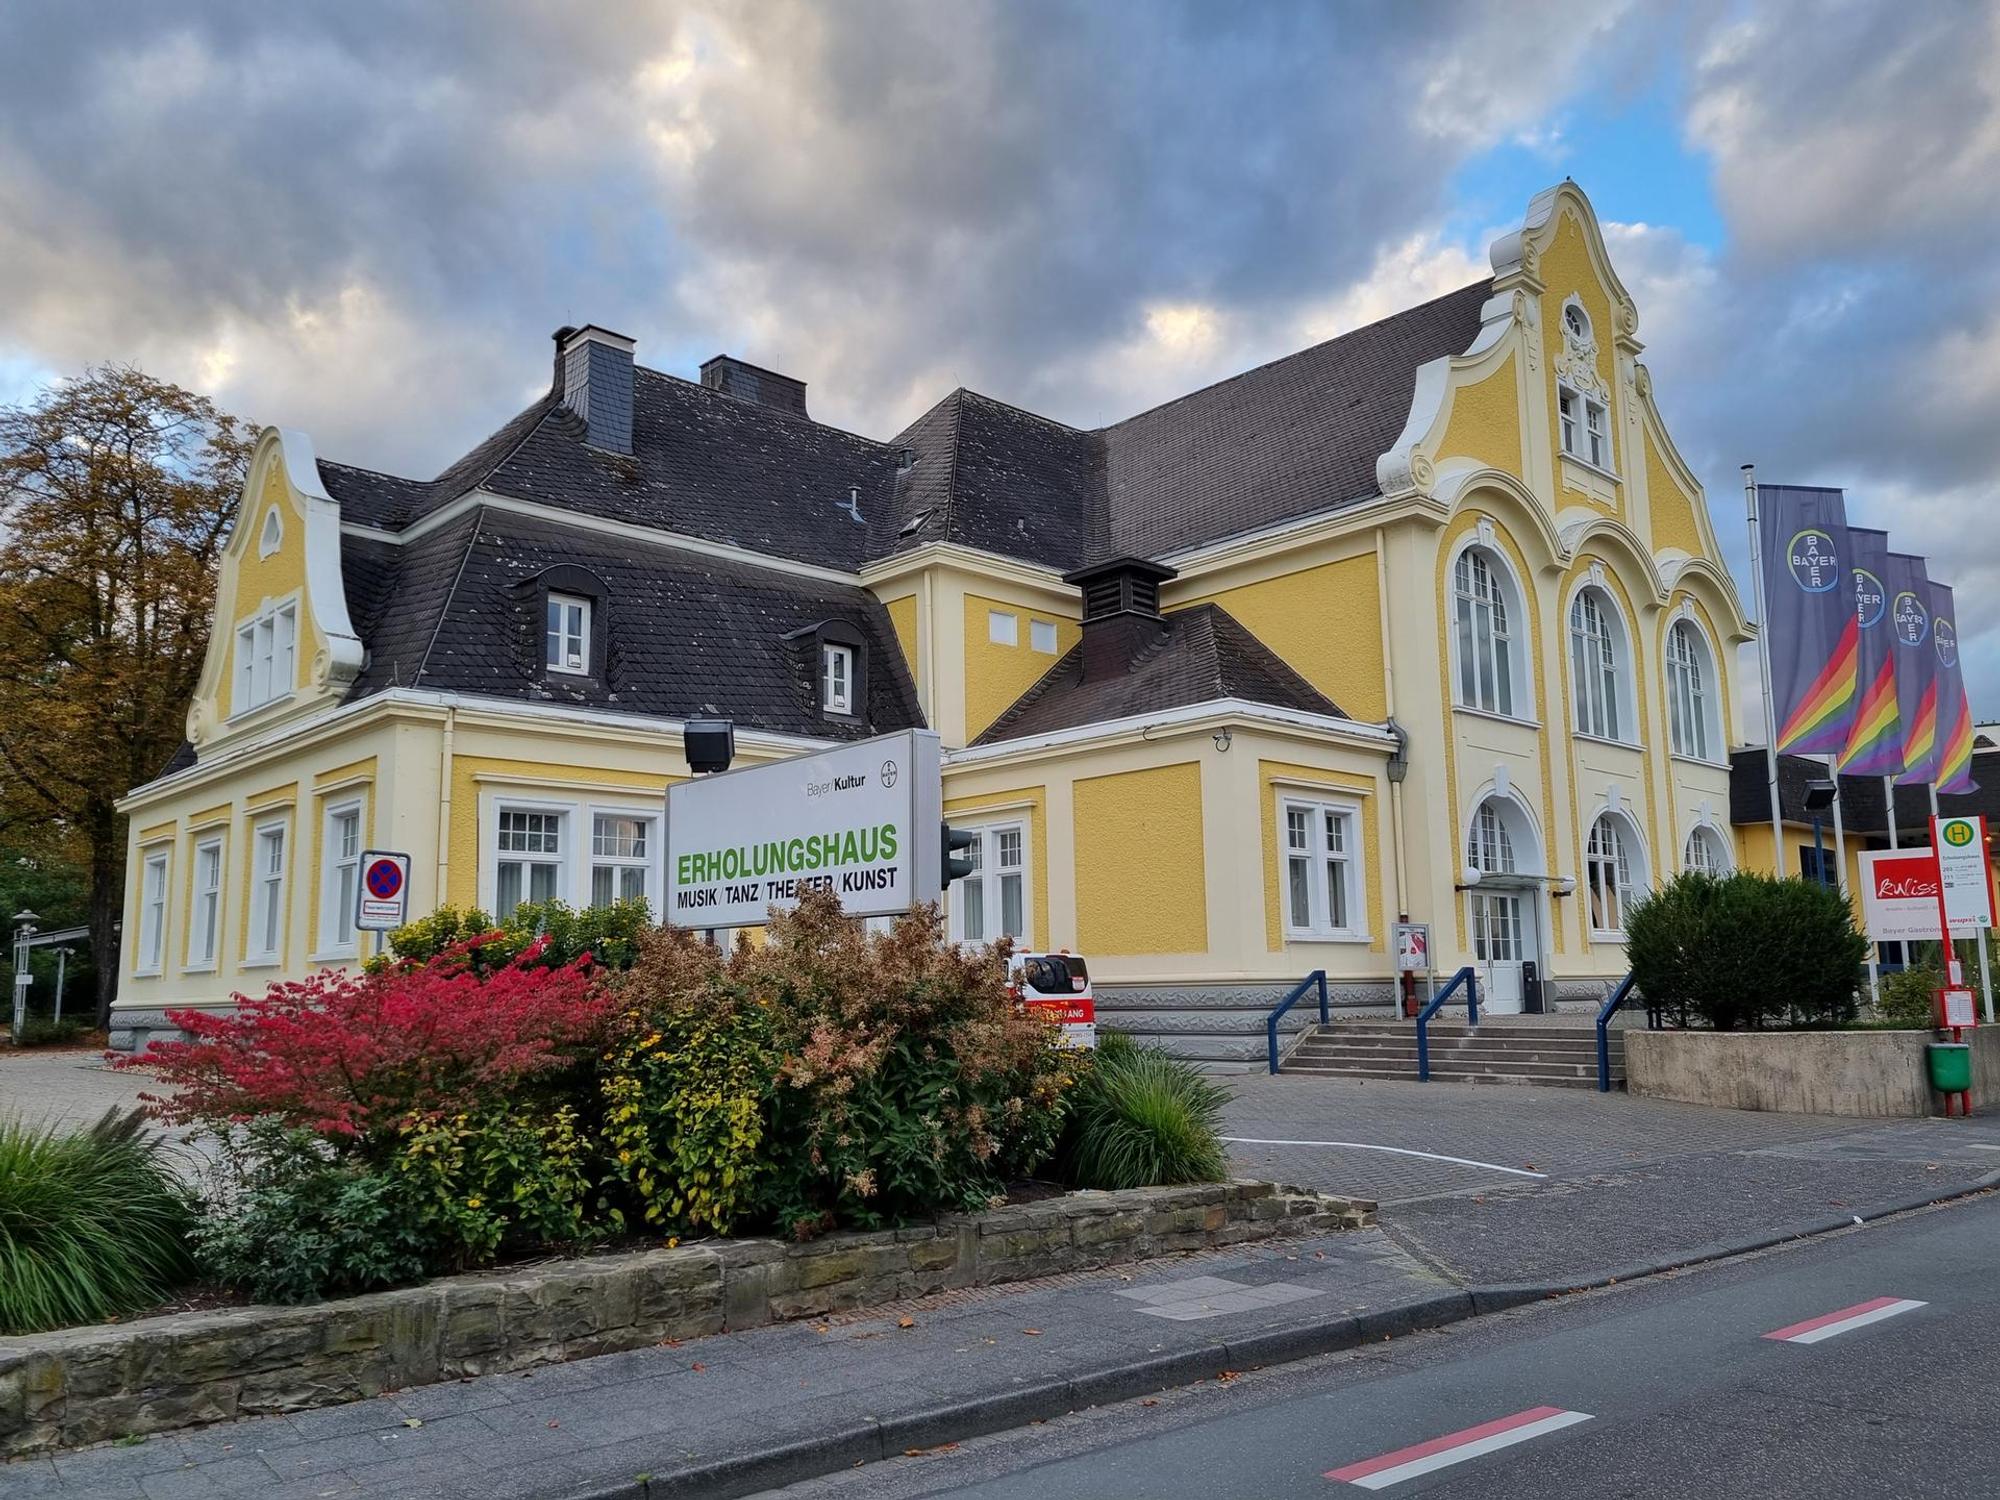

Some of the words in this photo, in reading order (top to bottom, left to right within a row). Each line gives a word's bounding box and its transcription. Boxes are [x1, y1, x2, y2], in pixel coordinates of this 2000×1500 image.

[1792, 555, 1837, 566] BAYER
[1807, 535, 1822, 587] BAYER
[1856, 573, 1865, 623] BAYER
[1904, 596, 1918, 641] BAYER
[677, 823, 898, 885] ERHOLUNGSHAUS
[1952, 826, 1966, 841] H
[677, 888, 718, 909] MUSIK
[725, 884, 759, 904] TANZ
[842, 867, 898, 893] KUNST
